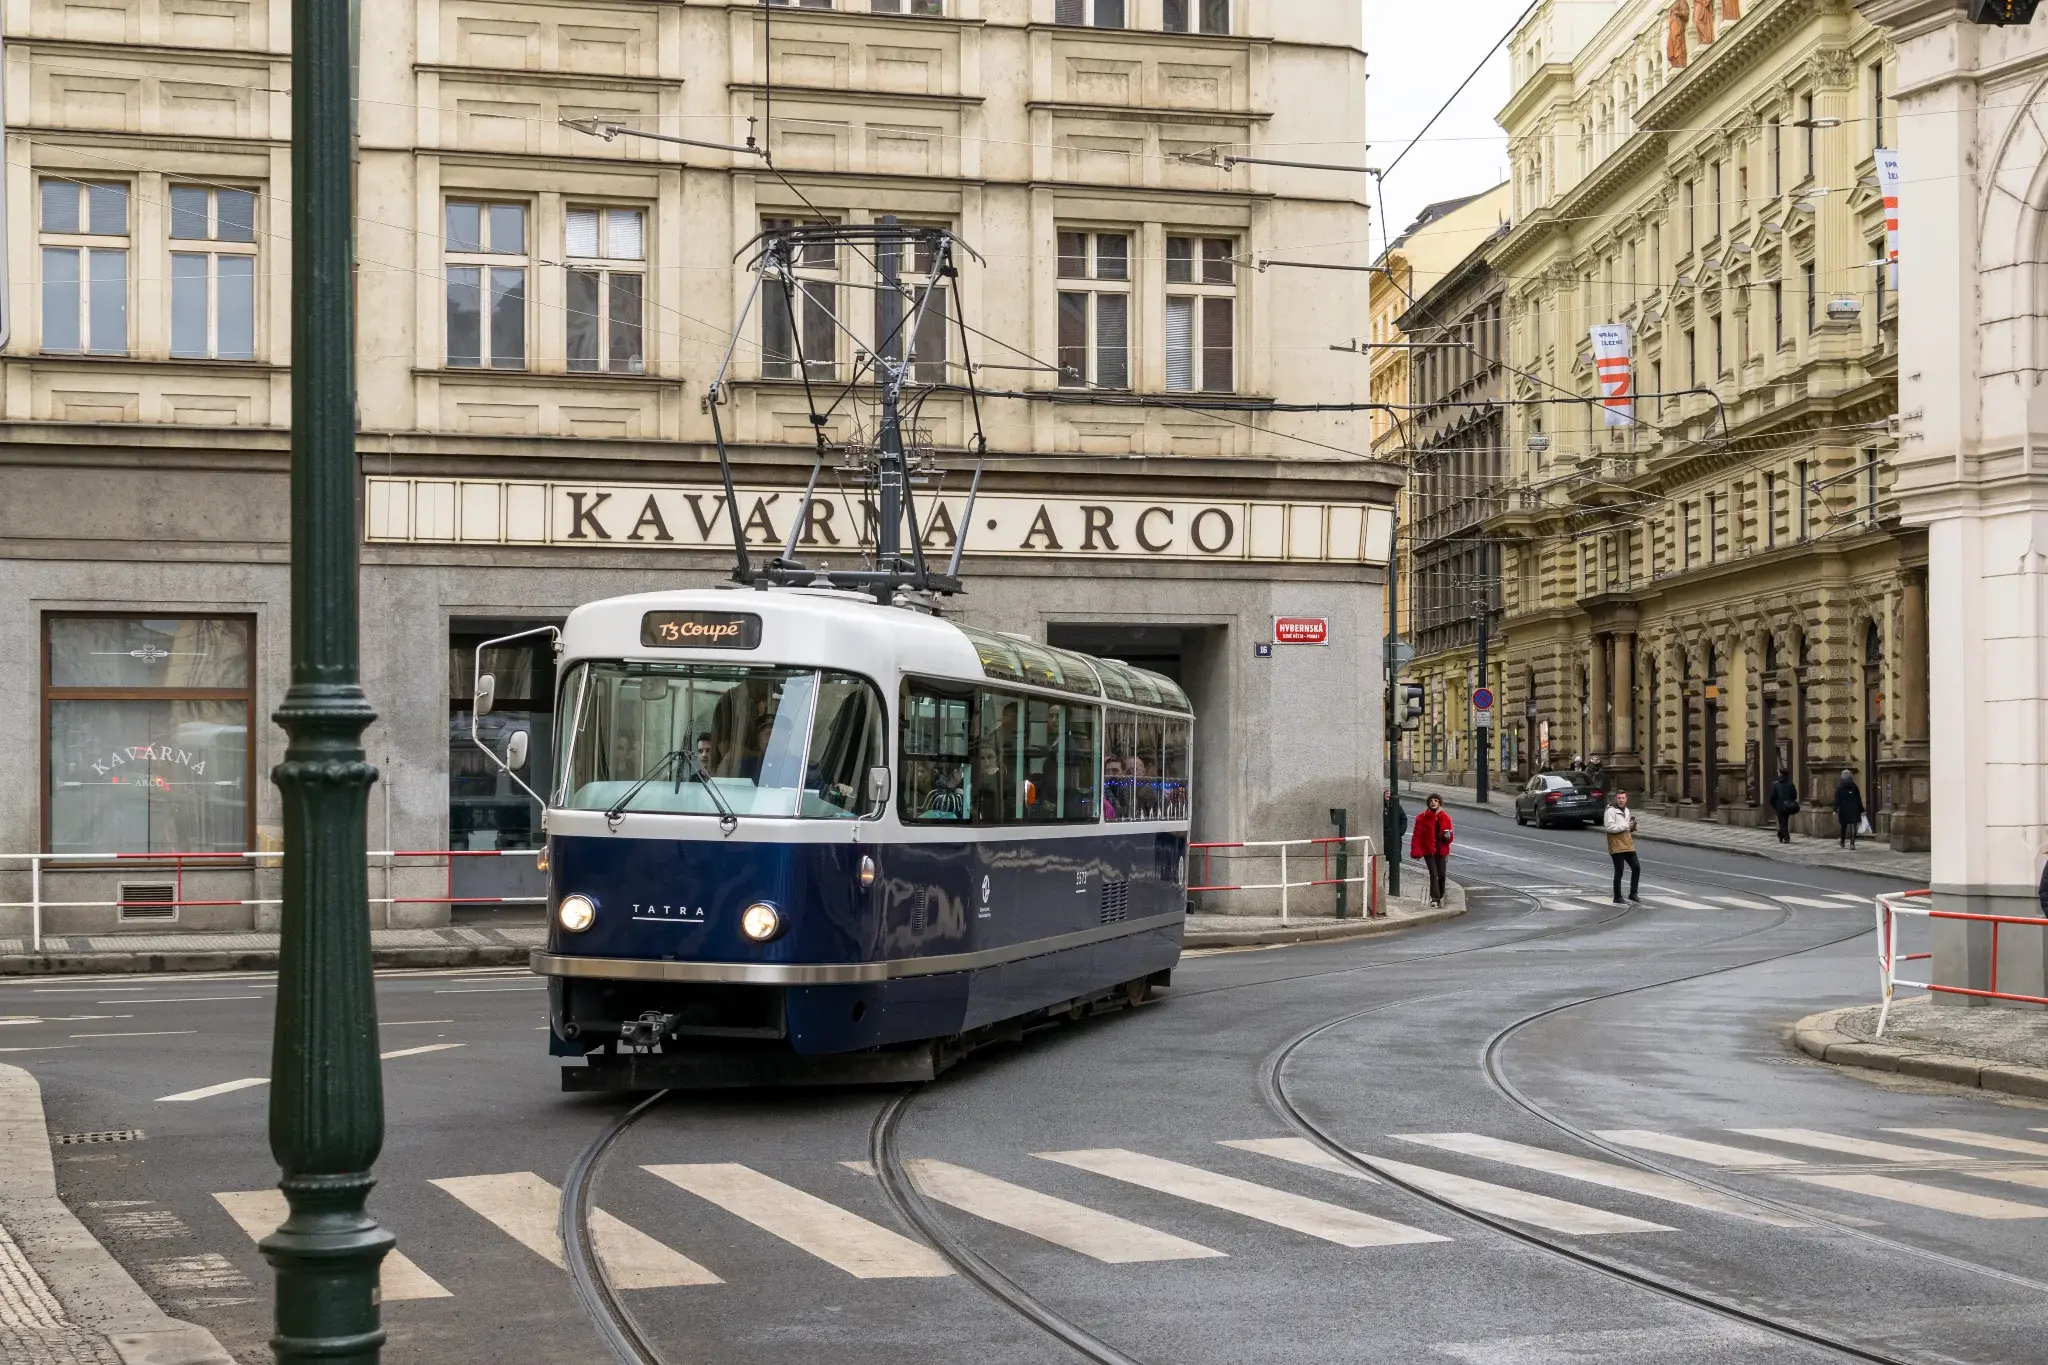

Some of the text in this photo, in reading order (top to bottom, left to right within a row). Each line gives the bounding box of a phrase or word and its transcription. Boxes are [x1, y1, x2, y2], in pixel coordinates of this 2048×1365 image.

[1020, 504, 1234, 554] ARCO
[659, 620, 744, 641] T3 Coupé
[1259, 645, 1268, 654] 16
[91, 743, 206, 776] KAVÁRNA
[134, 779, 164, 788] ARCO
[632, 904, 704, 916] TATRA
